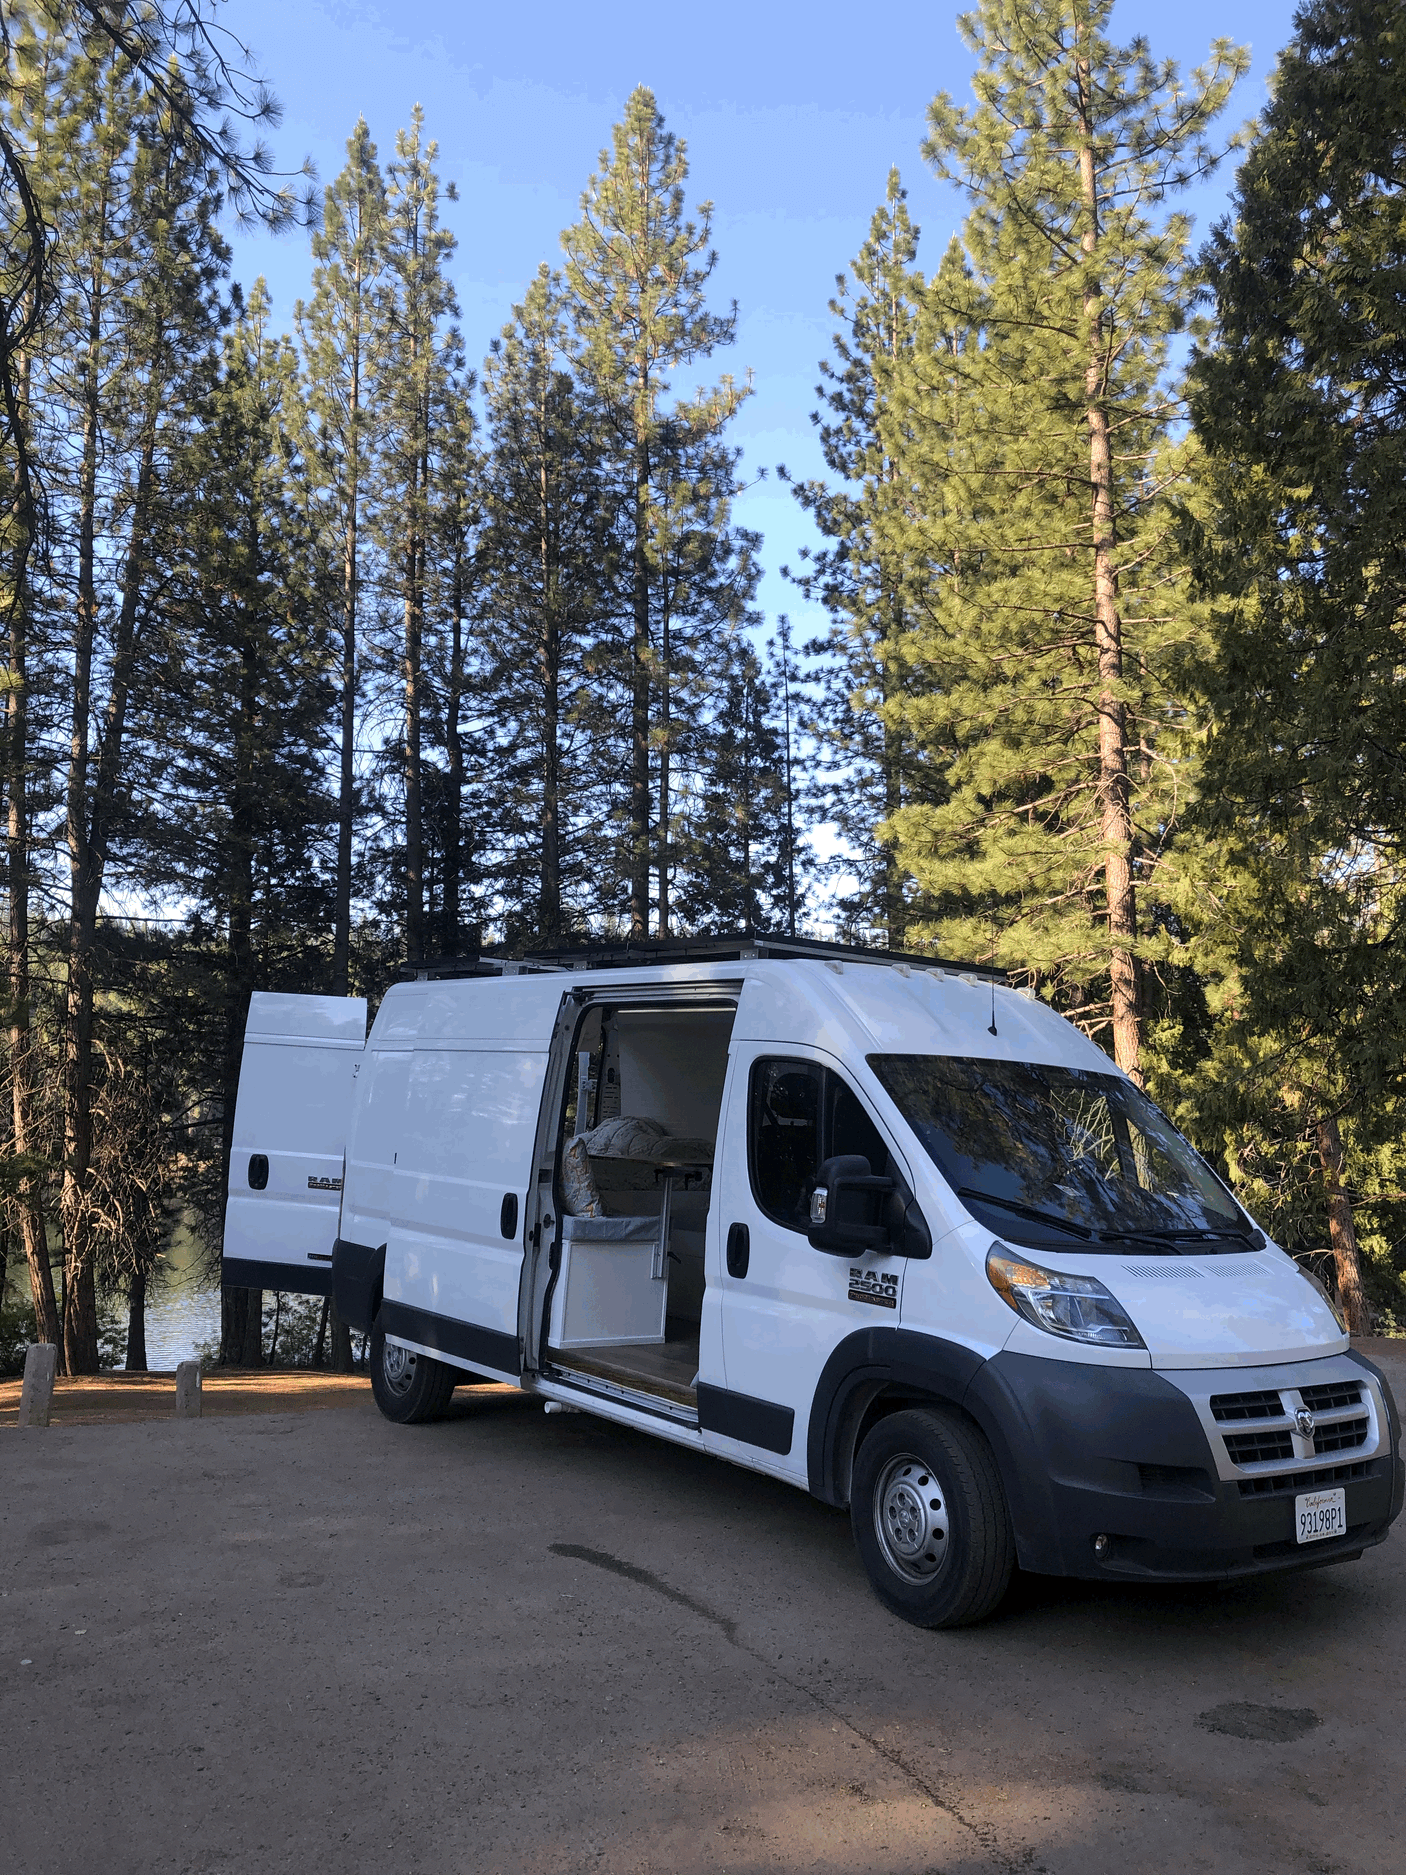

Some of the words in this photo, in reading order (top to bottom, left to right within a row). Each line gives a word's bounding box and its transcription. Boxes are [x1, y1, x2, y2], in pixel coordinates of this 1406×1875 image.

[849, 1267, 899, 1286] RAM
[848, 1278, 897, 1297] 2500
[1300, 1506, 1343, 1536] 93198P1
